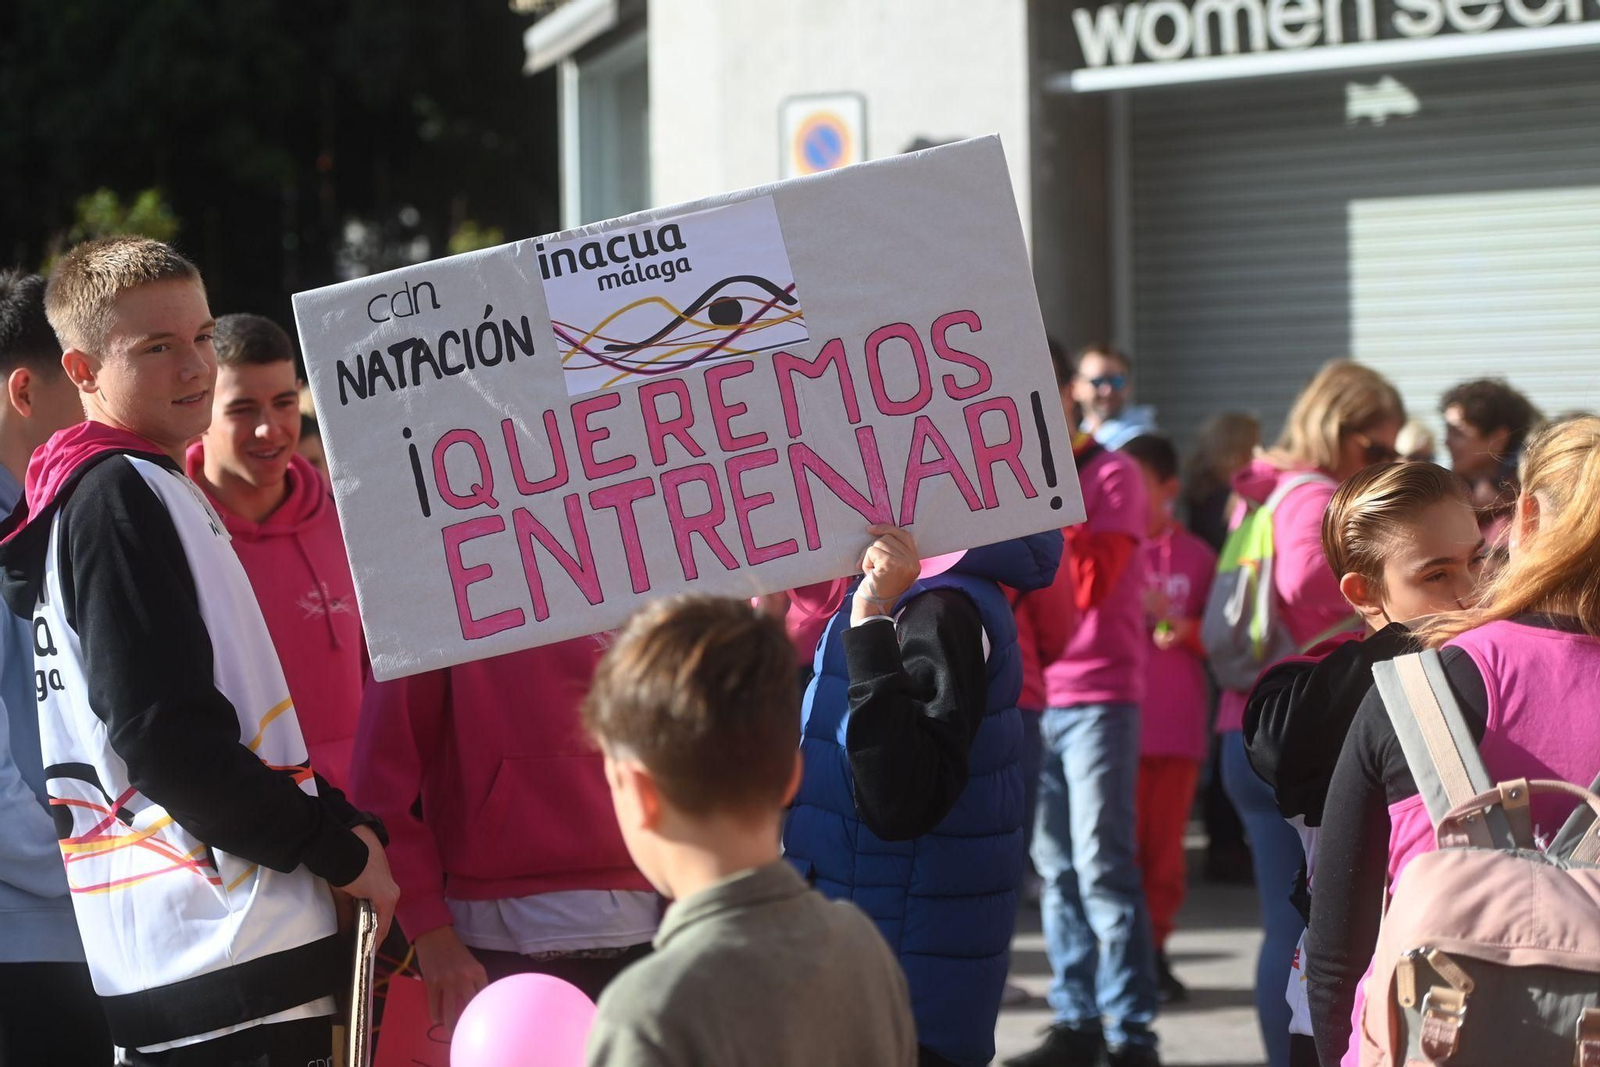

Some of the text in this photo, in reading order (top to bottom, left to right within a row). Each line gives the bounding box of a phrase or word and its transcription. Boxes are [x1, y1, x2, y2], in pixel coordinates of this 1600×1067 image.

[1071, 0, 1378, 66] women
[535, 223, 687, 279] inacua
[597, 256, 692, 291] málaga
[367, 280, 441, 323] cdn
[336, 304, 535, 405] NATACIÓN
[402, 309, 993, 518] ¡QUEREMOS
[441, 390, 1063, 641] ENTRENAR!
